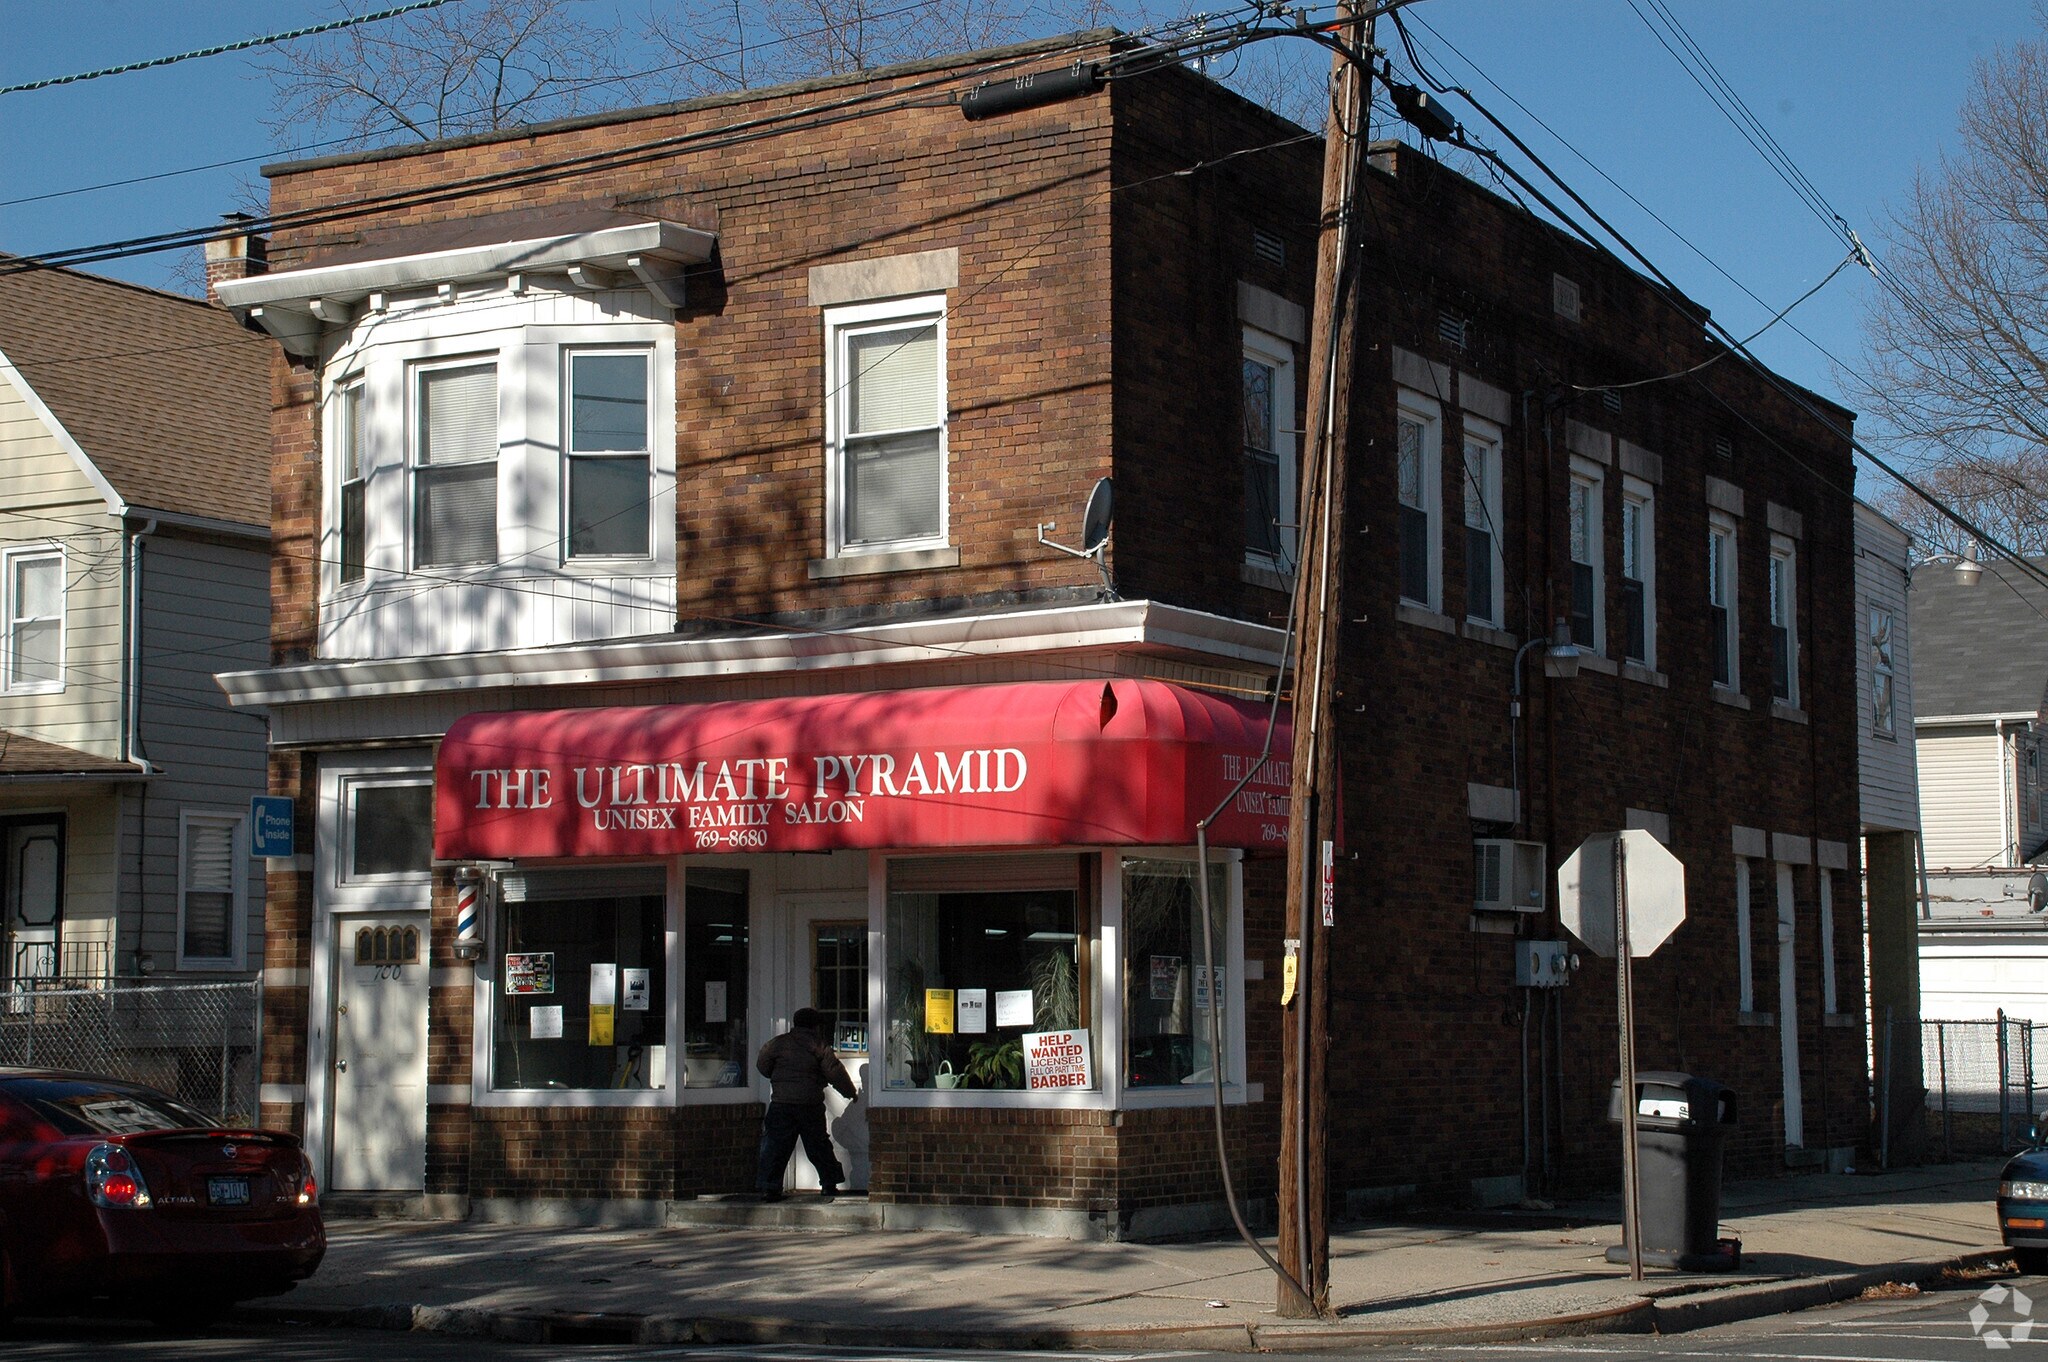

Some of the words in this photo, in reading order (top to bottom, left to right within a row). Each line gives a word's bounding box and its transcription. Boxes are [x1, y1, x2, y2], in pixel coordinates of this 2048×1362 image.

[1222, 754, 1242, 782] THE
[470, 767, 552, 811] THE
[573, 756, 791, 809] ULTIMATE
[813, 747, 1029, 799] PYRAMID
[1236, 790, 1265, 815] UNISEX
[1267, 794, 1290, 817] FAMIL
[265, 814, 291, 827] Phone
[594, 806, 677, 832] UNISEX
[688, 802, 772, 829] FAMILY
[784, 798, 865, 825] SALON
[693, 828, 768, 849] 769-8680
[1039, 1034, 1072, 1046] HELP
[1031, 1045, 1083, 1058] WANTED
[1031, 1056, 1084, 1068] LICENSED
[1029, 1067, 1044, 1076] FULL
[1045, 1066, 1054, 1075] OR
[1054, 1065, 1069, 1074] PART
[1071, 1063, 1086, 1073] TIME
[1031, 1073, 1086, 1089] BARBER
[157, 1196, 196, 1205] ALTIMA
